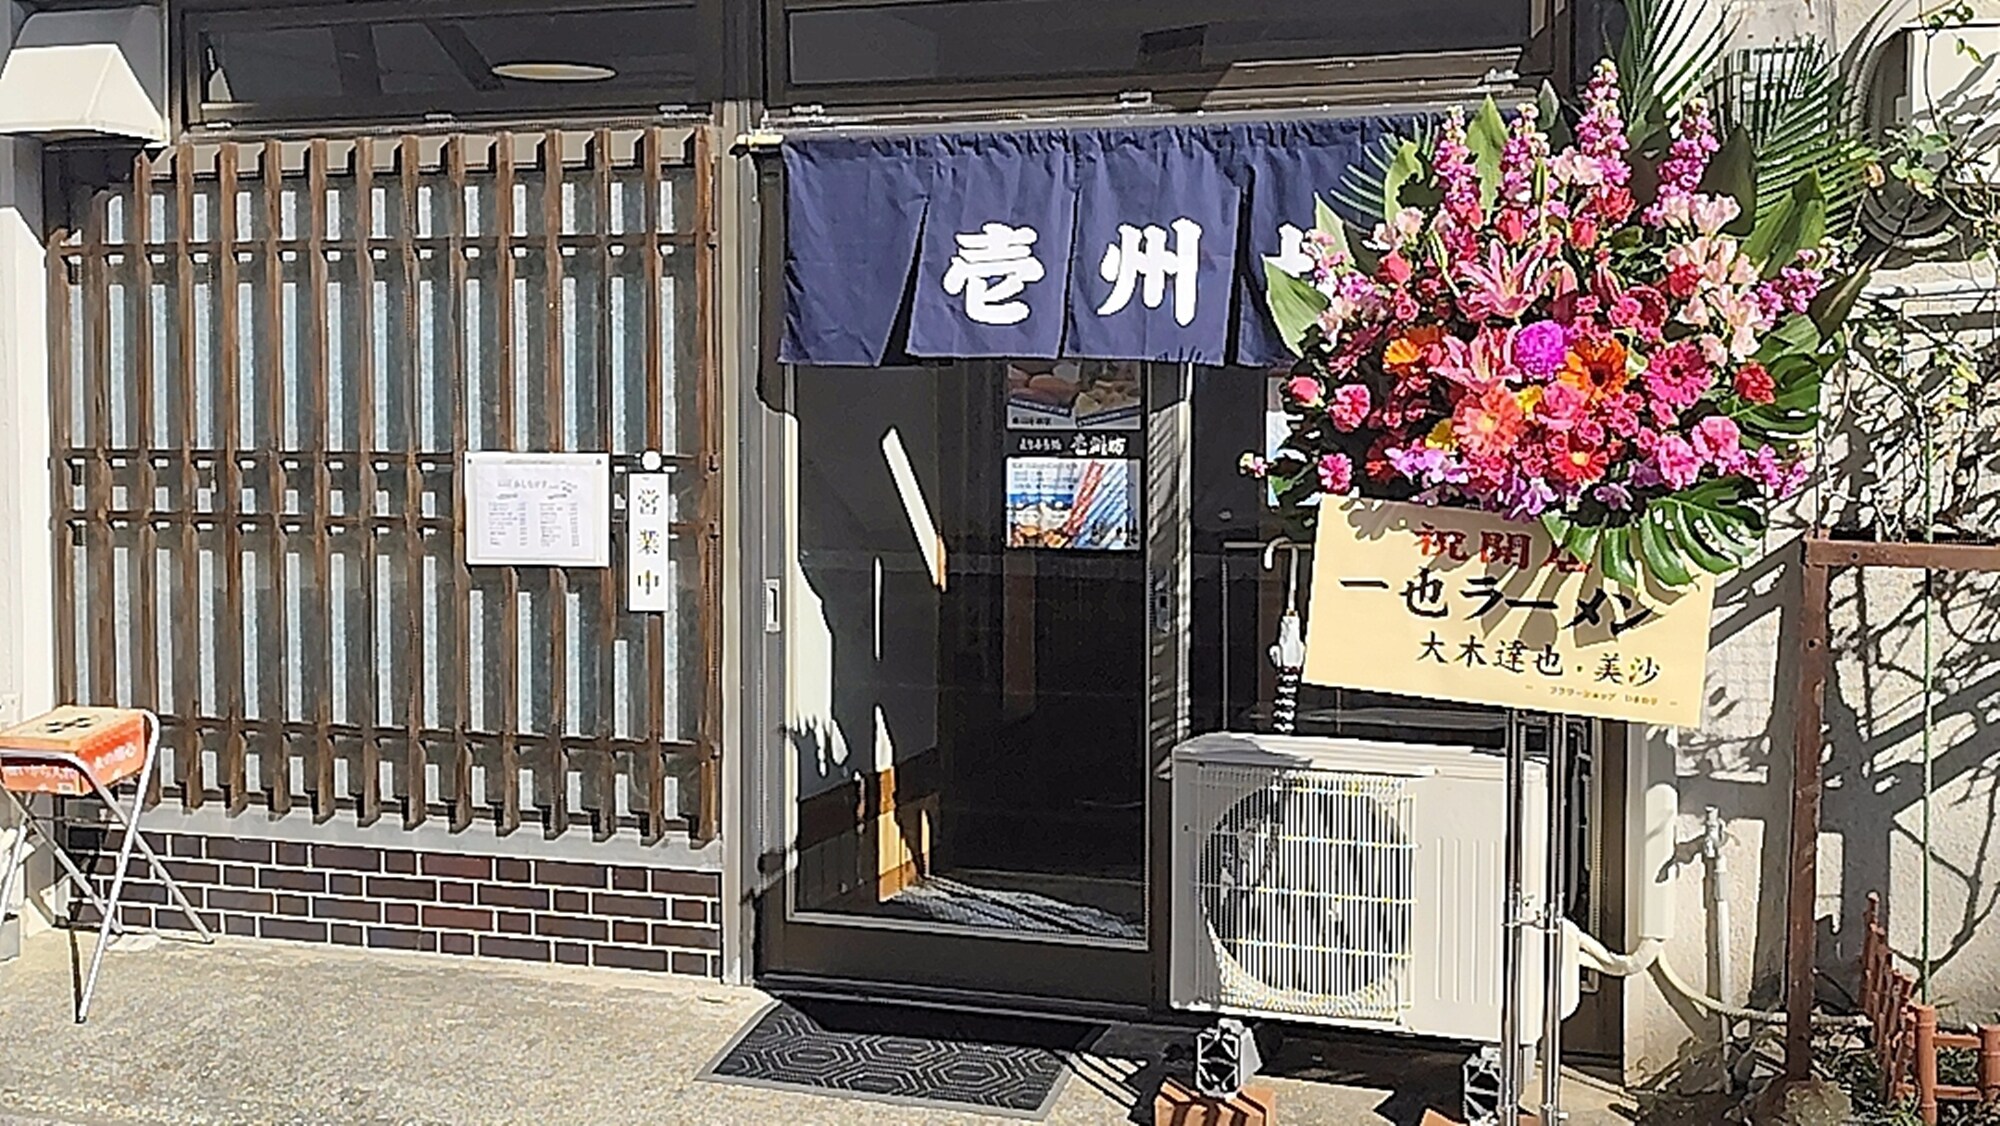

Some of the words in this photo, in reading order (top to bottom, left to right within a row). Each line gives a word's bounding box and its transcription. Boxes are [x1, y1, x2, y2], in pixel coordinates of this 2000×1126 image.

[637, 487, 661, 596] 営業中
[1339, 566, 1656, 636] 一也ラーメン
